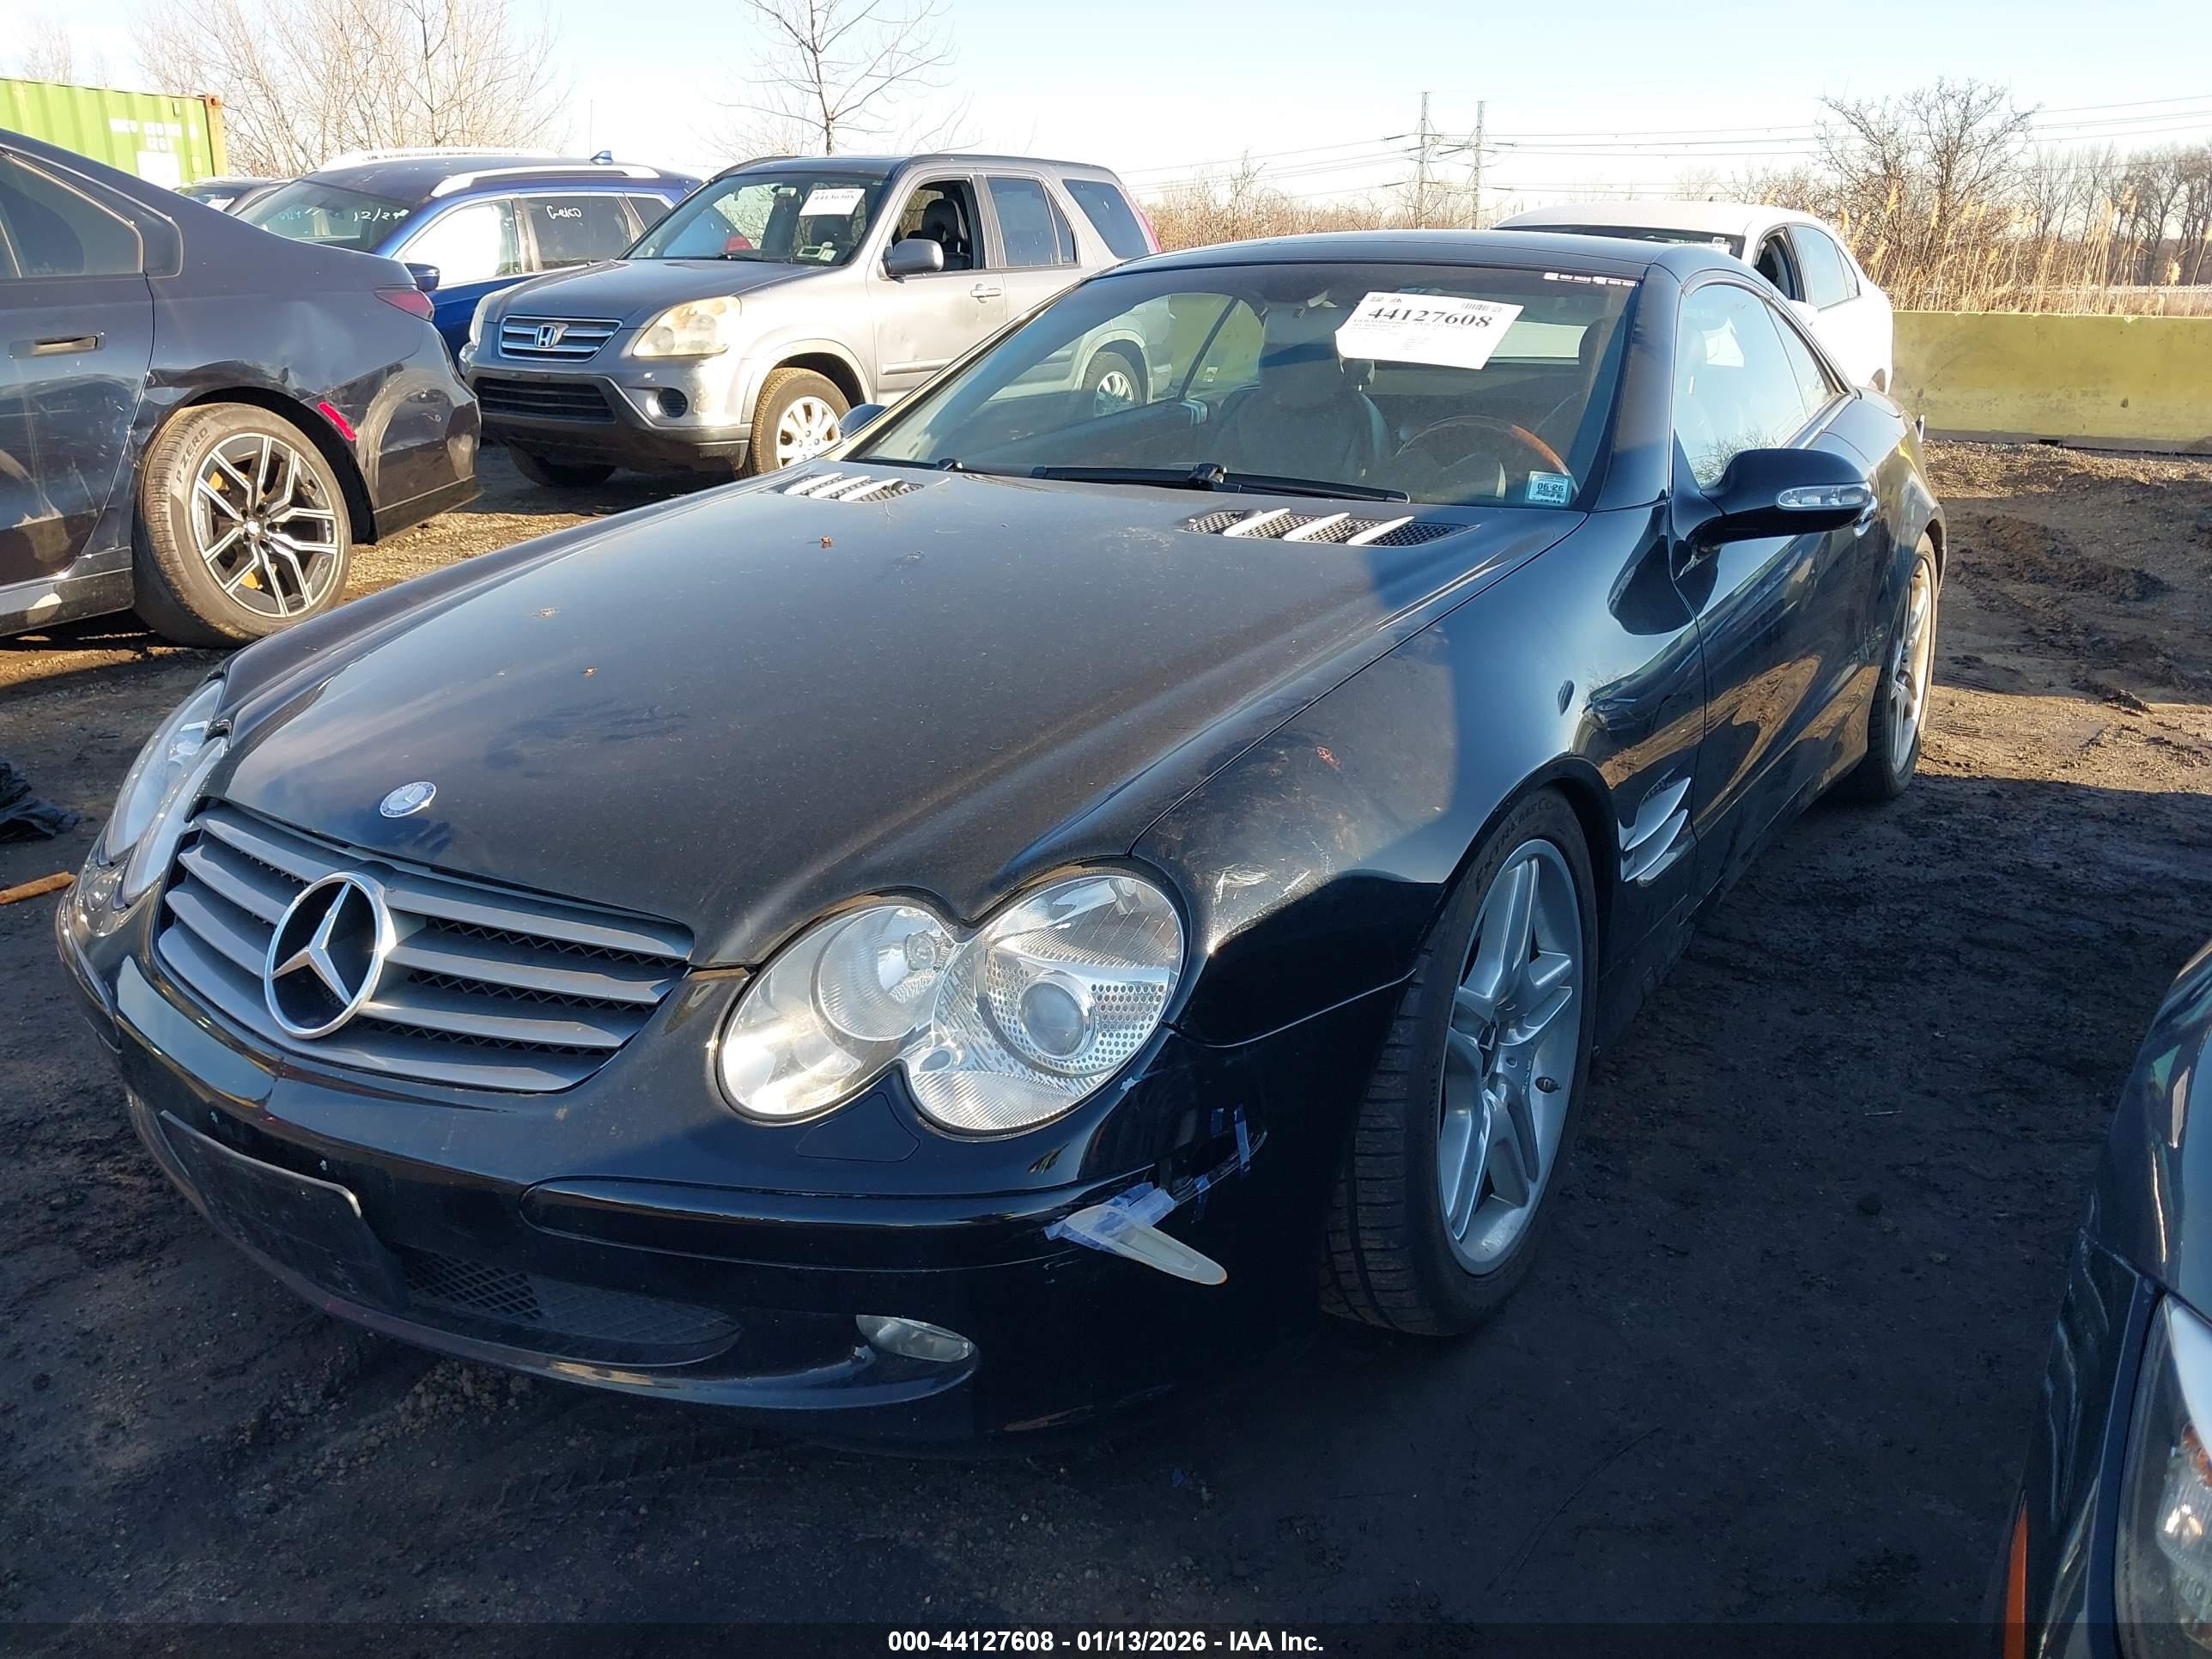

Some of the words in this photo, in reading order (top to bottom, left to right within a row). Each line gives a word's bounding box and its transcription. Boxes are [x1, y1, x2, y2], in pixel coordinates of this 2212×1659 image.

[546, 205, 582, 220] Geico
[1367, 307, 1494, 328] 44127608
[180, 427, 209, 470] ZERO
